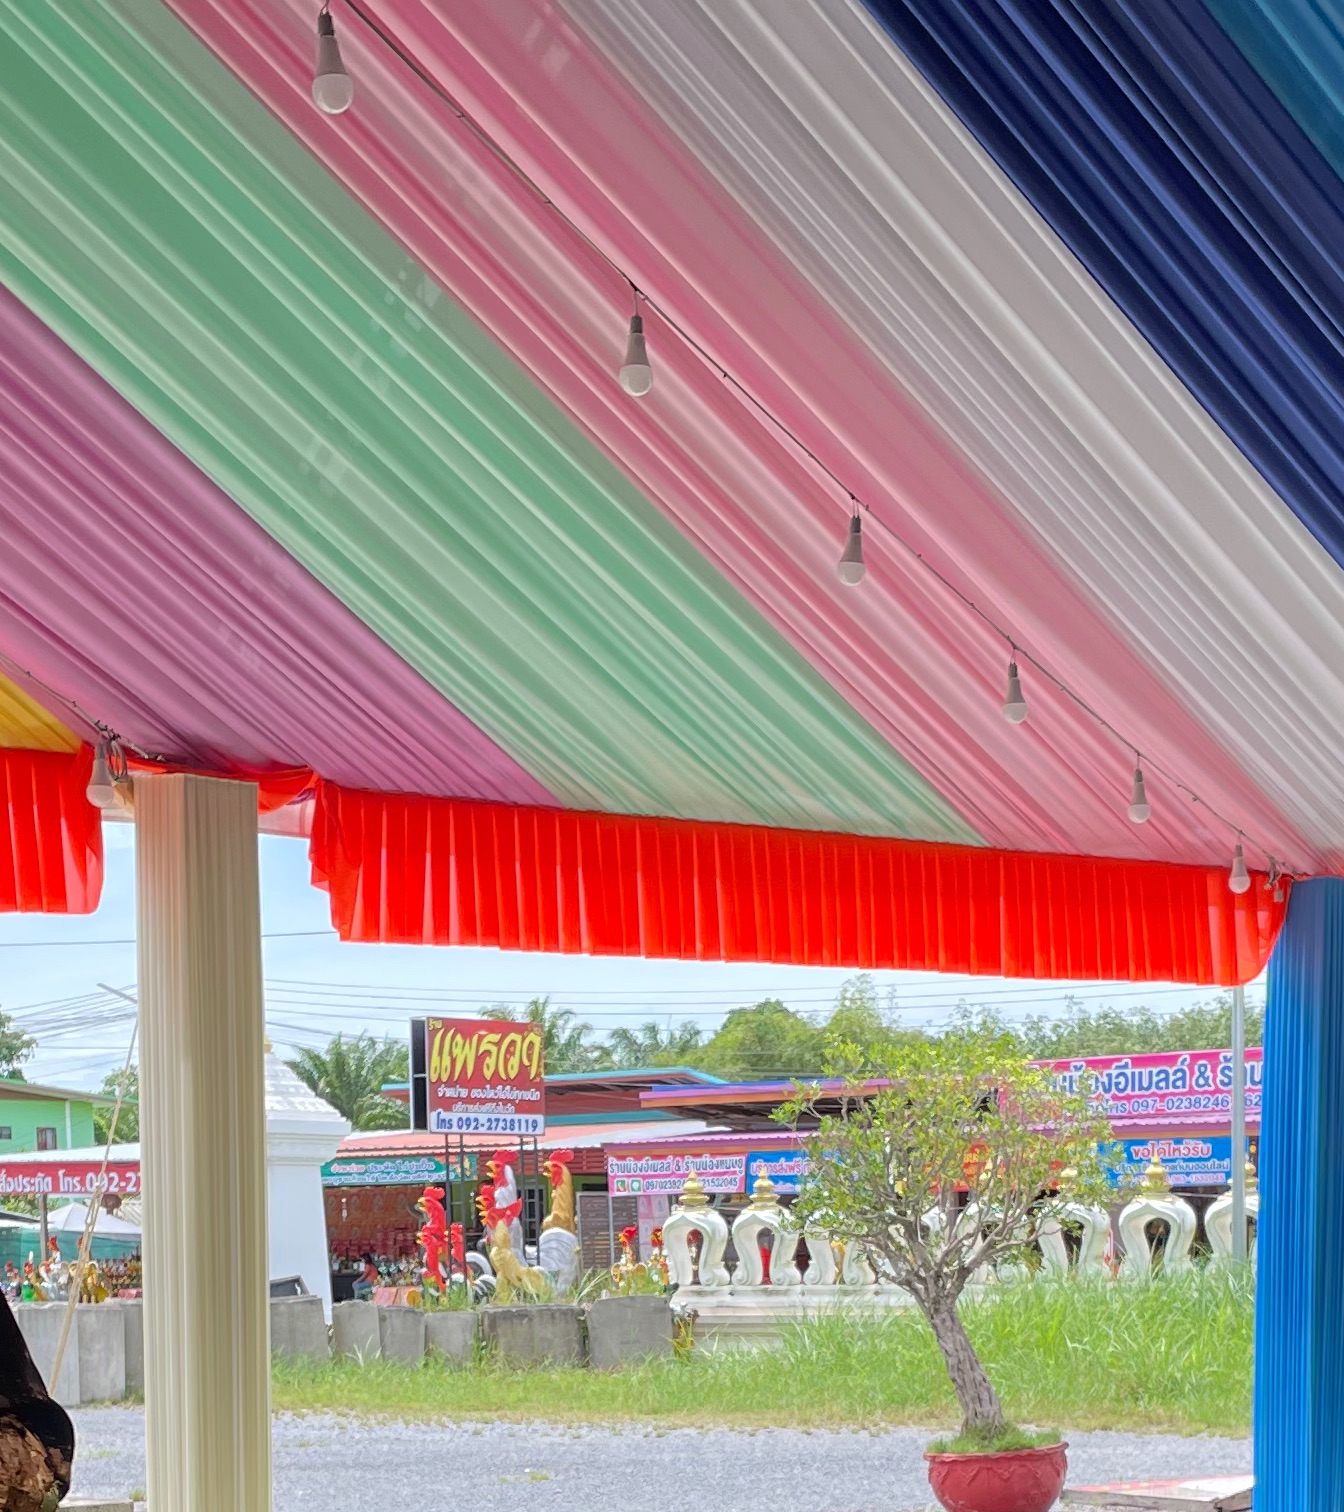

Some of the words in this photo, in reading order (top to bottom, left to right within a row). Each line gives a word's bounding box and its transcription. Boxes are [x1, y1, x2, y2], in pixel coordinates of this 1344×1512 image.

[1194, 1063, 1212, 1088] &
[436, 1110, 453, 1130] โทร
[457, 1116, 538, 1132] 092-2738119
